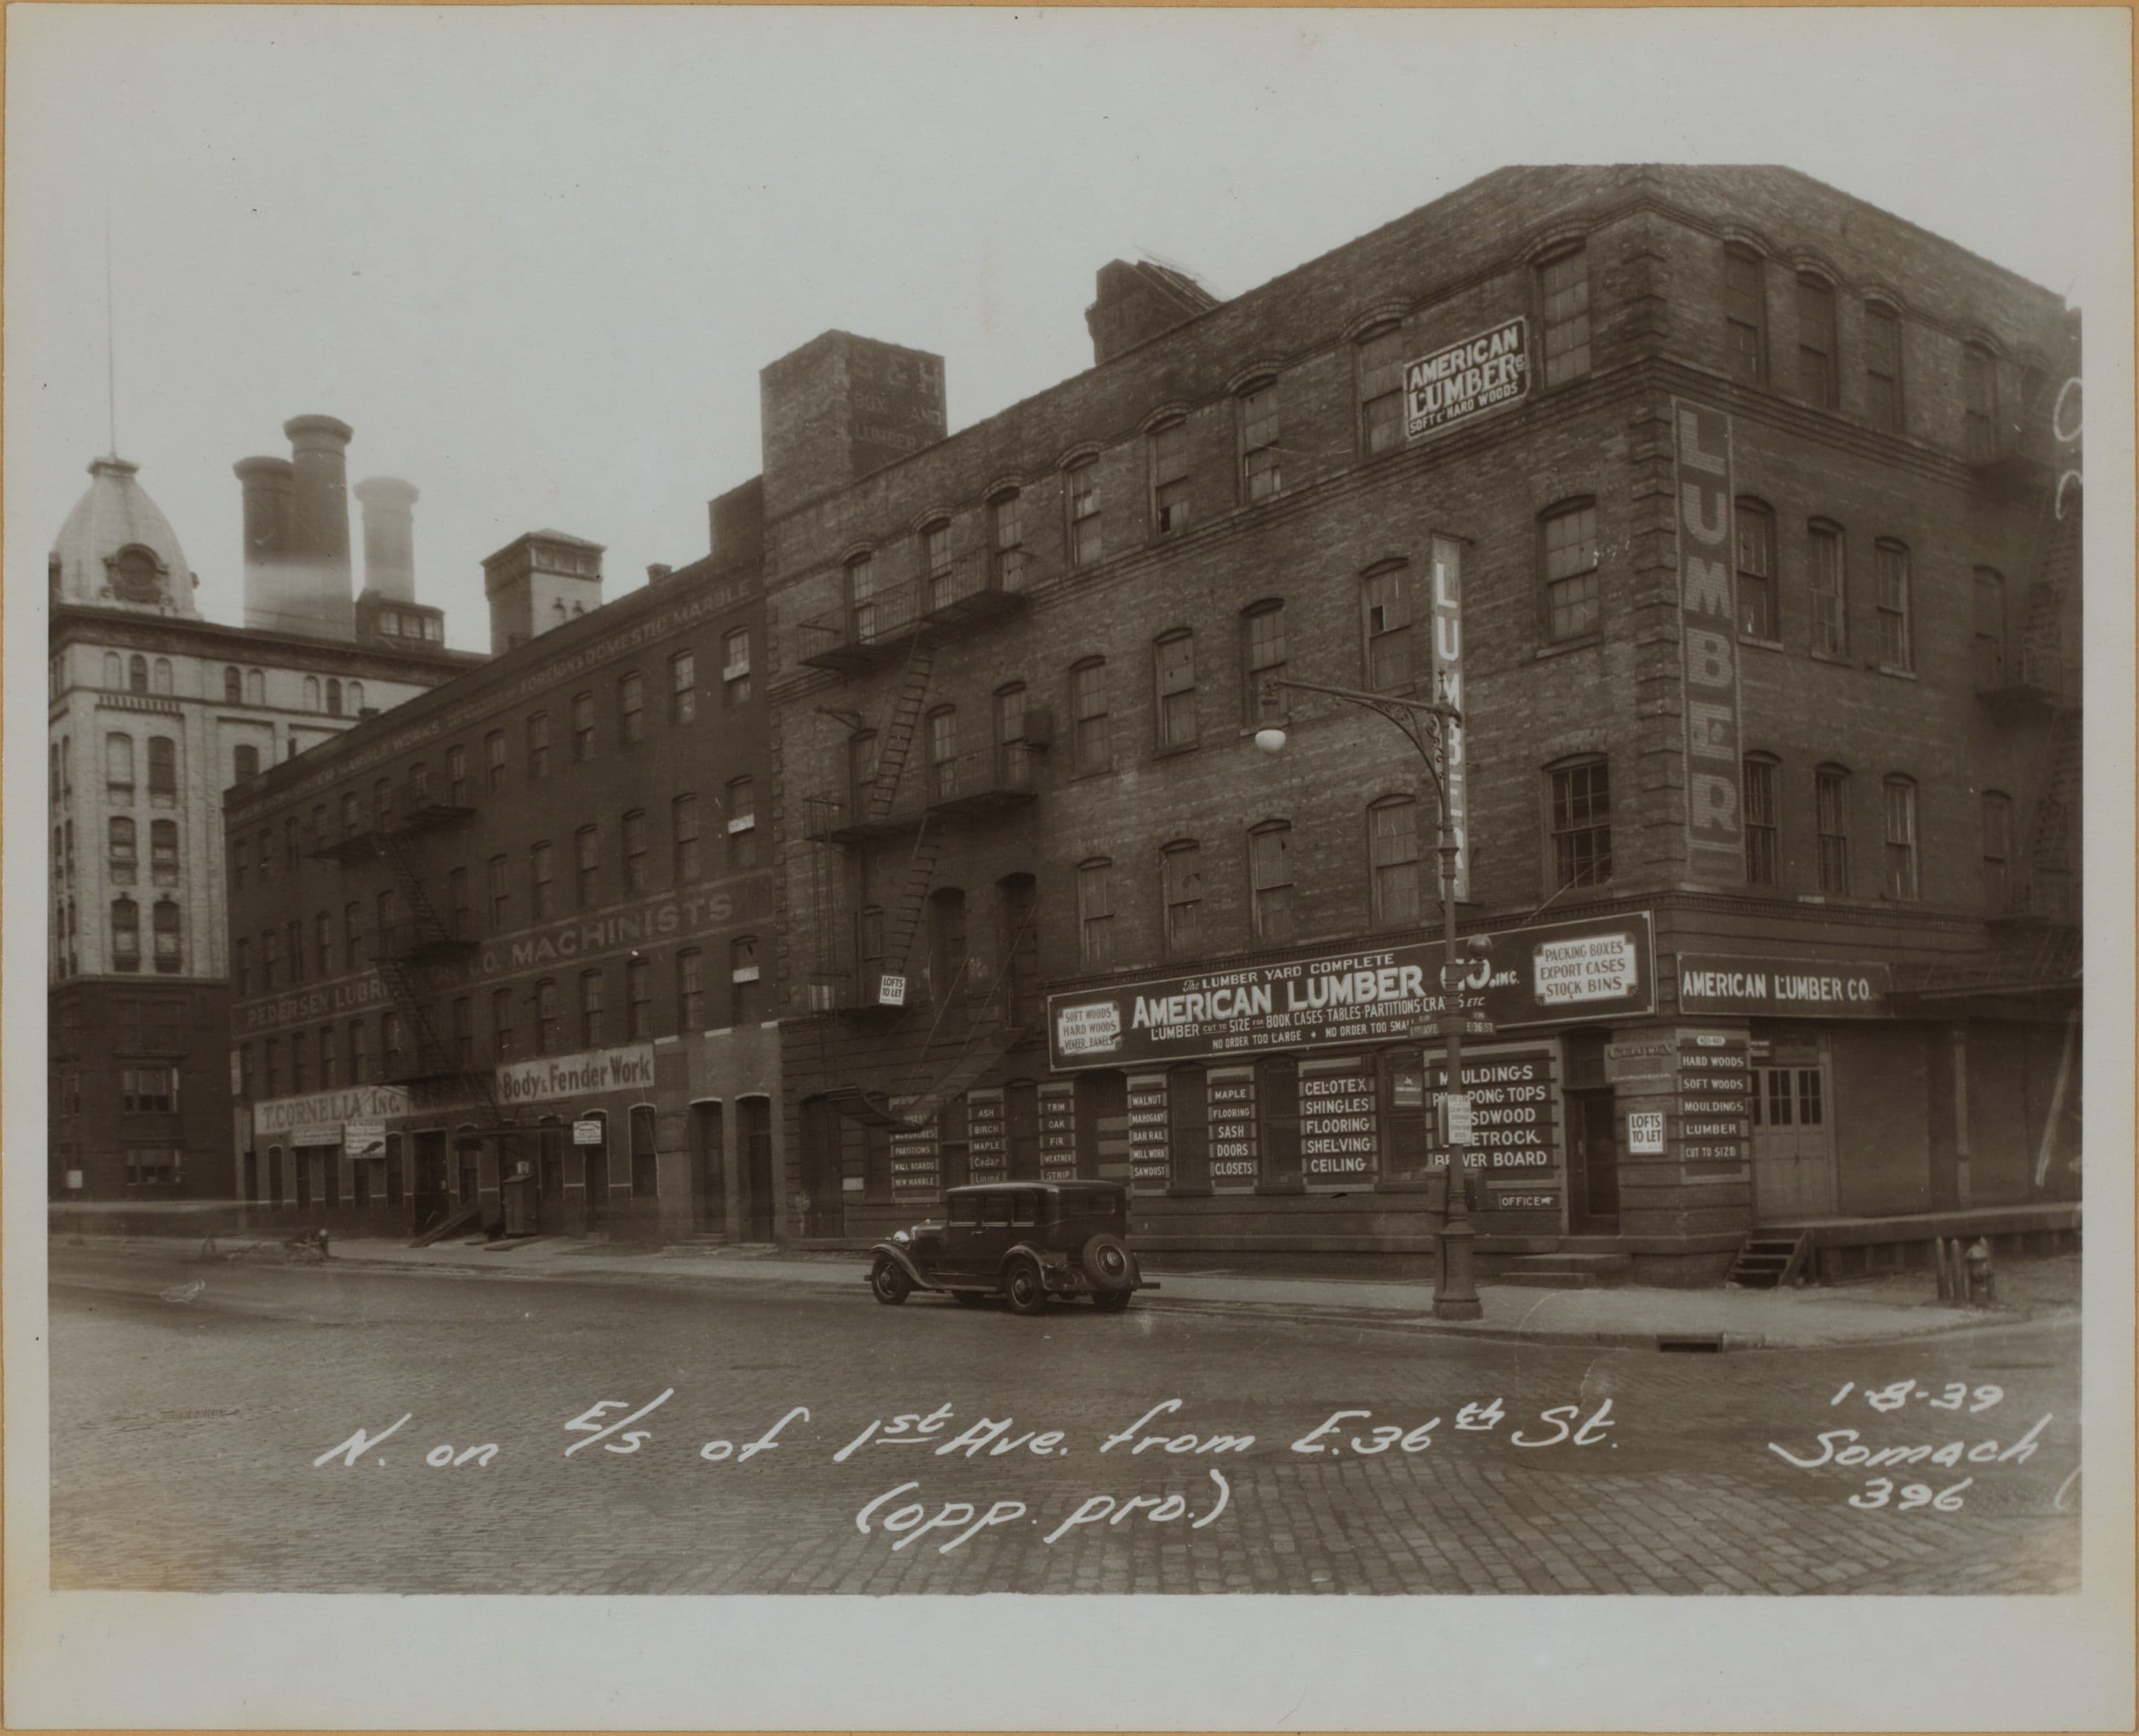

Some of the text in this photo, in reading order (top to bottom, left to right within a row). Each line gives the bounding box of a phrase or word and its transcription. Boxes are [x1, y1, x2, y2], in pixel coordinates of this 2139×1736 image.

[1409, 325, 1518, 392] AMERICAN
[1409, 353, 1518, 420] LUMBER
[1409, 413, 1435, 434] SOFT
[1447, 399, 1474, 418] HARD
[1478, 381, 1518, 407] WOODS
[674, 579, 750, 626] MARBLE
[1679, 408, 1737, 832] LUMBER
[1545, 940, 1623, 962] PACKING BOXES
[249, 992, 328, 1026] PEDERSEN
[512, 893, 732, 965] MACHINISTS
[1183, 953, 1394, 992] The LUMBER YARD COMPLETE
[1540, 958, 1625, 980] EXPORT CASES
[884, 977, 903, 988] LOFTS
[1546, 976, 1622, 998] STOCK BINS
[1682, 970, 1767, 998] AMERICAN
[1774, 974, 1843, 1001] LUMBER
[883, 988, 902, 998] TO LET
[1130, 983, 1273, 1030] AMERICAN
[1287, 964, 1426, 1013] LUMBER
[1065, 1006, 1112, 1023] SOFT WOODS
[1151, 1024, 1199, 1041] LUMBER
[1203, 1024, 1216, 1033] CUT
[1229, 1018, 1250, 1033] SIZE
[1253, 1018, 1265, 1027] FOR
[1265, 1013, 1290, 1028] BOOK
[1295, 1009, 1322, 1025] CASES
[1327, 1006, 1362, 1022] TABLES
[1364, 998, 1421, 1019] PARTITIONS
[1423, 993, 1464, 1012] CRAS
[1063, 1020, 1117, 1036] HARD WOODS
[1466, 1021, 1493, 1033] E 36 ST
[1090, 1035, 1114, 1047] PANELS
[1213, 1038, 1223, 1049] NO
[1225, 1035, 1248, 1048] ORDER
[1253, 1033, 1268, 1045] TOO
[1271, 1030, 1302, 1043] LARGE
[1325, 1026, 1337, 1038] NO
[1340, 1023, 1367, 1037] ORDER
[1370, 1021, 1387, 1034] TOO
[1682, 1055, 1744, 1068] HARD WOODS
[503, 1072, 541, 1099] Body
[550, 1066, 607, 1092] Fender
[610, 1055, 651, 1083] Work
[1439, 1065, 1533, 1086] MULDINGS
[1305, 1078, 1367, 1096] CELOTEX
[1683, 1078, 1744, 1090] SOFT WOODS
[1131, 1094, 1162, 1107] WALNUT
[1214, 1088, 1246, 1100] MAPLE
[1467, 1088, 1505, 1105] PONG
[1507, 1085, 1546, 1102] TOPS
[1047, 1102, 1065, 1112] TRIM
[1213, 1107, 1250, 1118] FLOORING
[1305, 1097, 1369, 1115] SHINGLES
[1684, 1101, 1744, 1112] MOULDINGS
[977, 1108, 994, 1118] ASH
[1131, 1112, 1164, 1125] MAHOGANY
[1048, 1120, 1065, 1130] OAK
[1306, 1117, 1370, 1134] FLOORING
[1632, 1115, 1660, 1128] LOFTS
[974, 1125, 998, 1135] BIRCH
[1217, 1125, 1244, 1138] SASH
[1686, 1123, 1737, 1135] LUMBER
[1050, 1137, 1065, 1146] FIR
[1133, 1130, 1164, 1142] BAR RAIL
[1632, 1130, 1661, 1142] TO LET
[894, 1146, 931, 1155] PARTITIONS
[973, 1140, 1000, 1151] MAPLE
[1216, 1143, 1248, 1157] DOORS
[1307, 1137, 1371, 1154] SHELVING
[1044, 1153, 1072, 1164] WEATHER
[1493, 1151, 1547, 1167] BOARD
[1686, 1147, 1699, 1158] CUT
[1702, 1147, 1711, 1157] TO
[894, 1162, 935, 1171] WALL BOARDS
[974, 1157, 1000, 1167] Cedar
[1310, 1157, 1367, 1173] CEILING
[1047, 1170, 1070, 1180] STRIP
[1134, 1166, 1166, 1177] SAWDUST
[1214, 1162, 1253, 1176] CLOSETS
[908, 1177, 934, 1187] MARBLE
[1501, 1197, 1540, 1207] OFFICE
